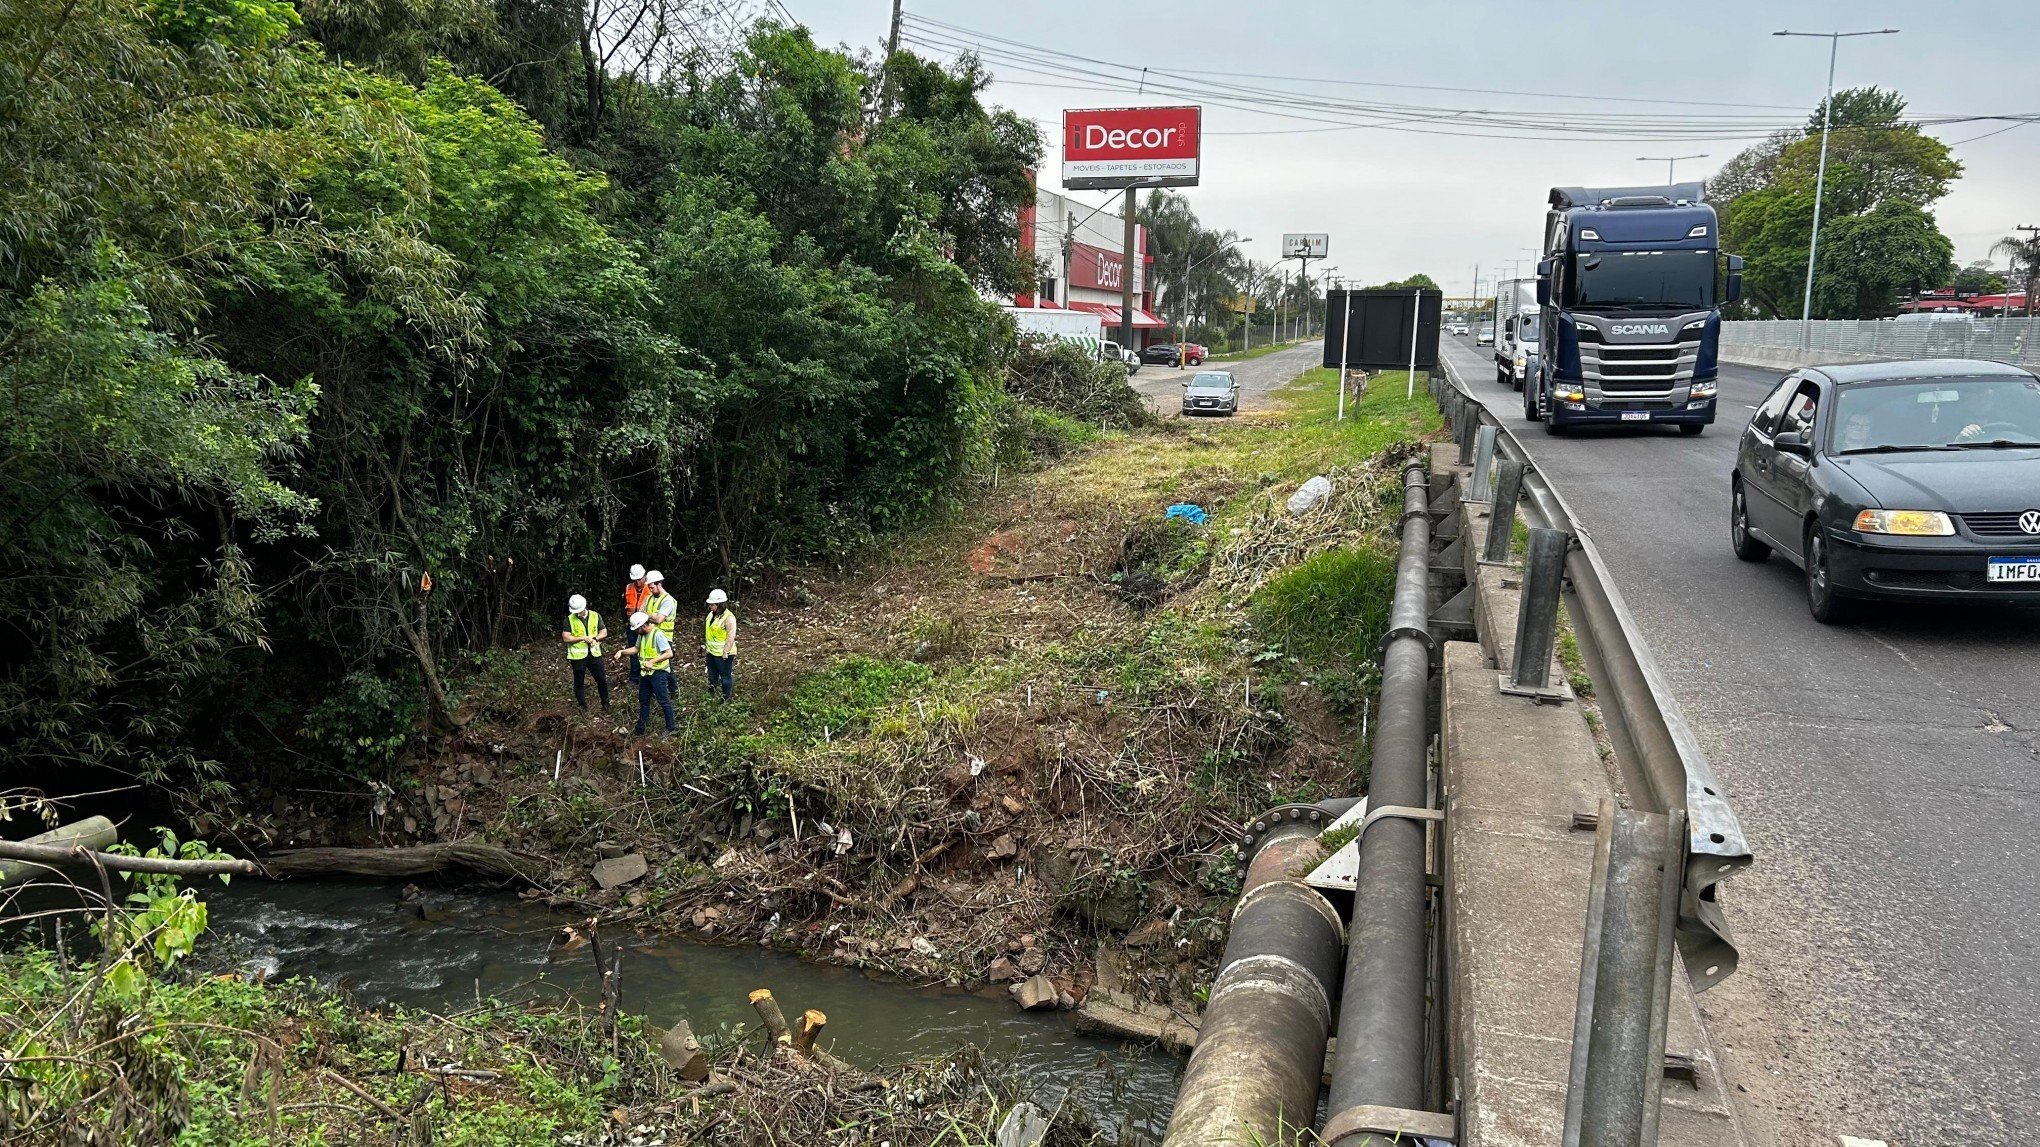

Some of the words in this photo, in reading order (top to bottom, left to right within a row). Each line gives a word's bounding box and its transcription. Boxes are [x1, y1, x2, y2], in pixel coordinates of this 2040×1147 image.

[1178, 122, 1187, 147] shop
[1073, 163, 1101, 172] MÓVEIS
[1106, 163, 1137, 171] TAPETES
[1144, 162, 1187, 171] ESTOFADOS
[1097, 252, 1123, 288] Decor
[1611, 324, 1669, 335] SCANIA
